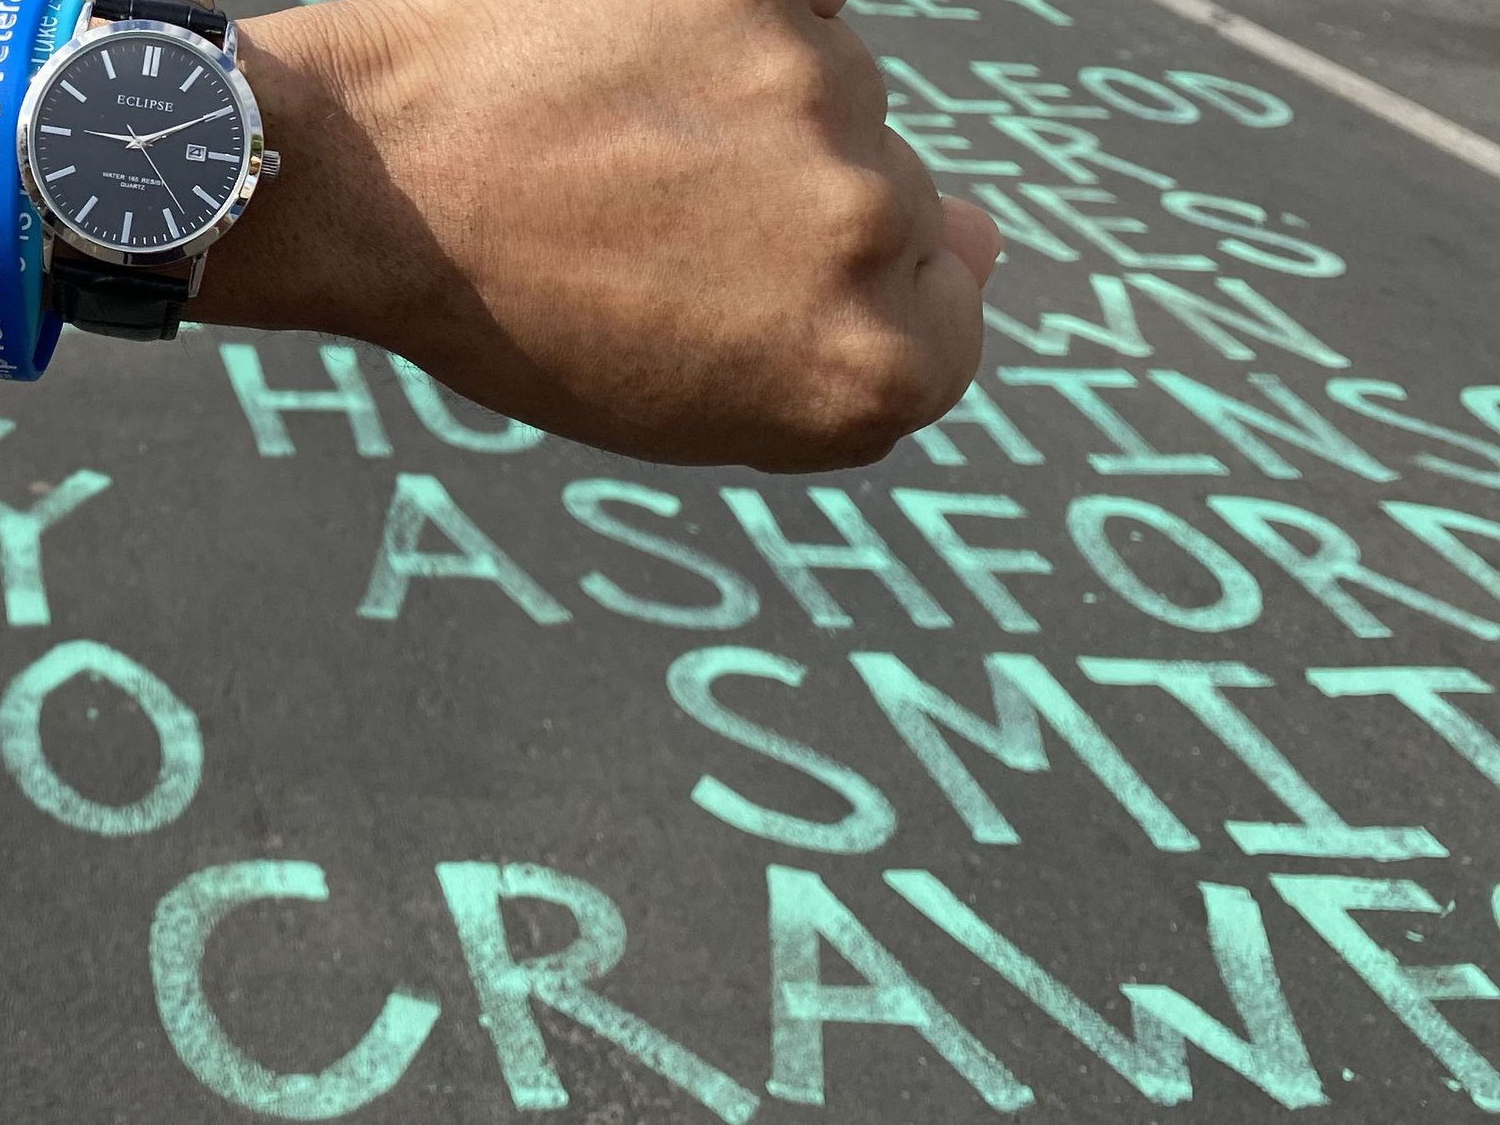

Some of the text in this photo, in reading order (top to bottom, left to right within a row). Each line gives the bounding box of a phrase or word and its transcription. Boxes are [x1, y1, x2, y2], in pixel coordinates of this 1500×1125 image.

[117, 94, 174, 113] ECLIPSE
[878, 55, 1295, 130] LEOD
[102, 172, 126, 181] WATER
[120, 181, 146, 191] QUARTZ
[666, 645, 1500, 859] SMIT
[148, 858, 1500, 1125] CRAWF
